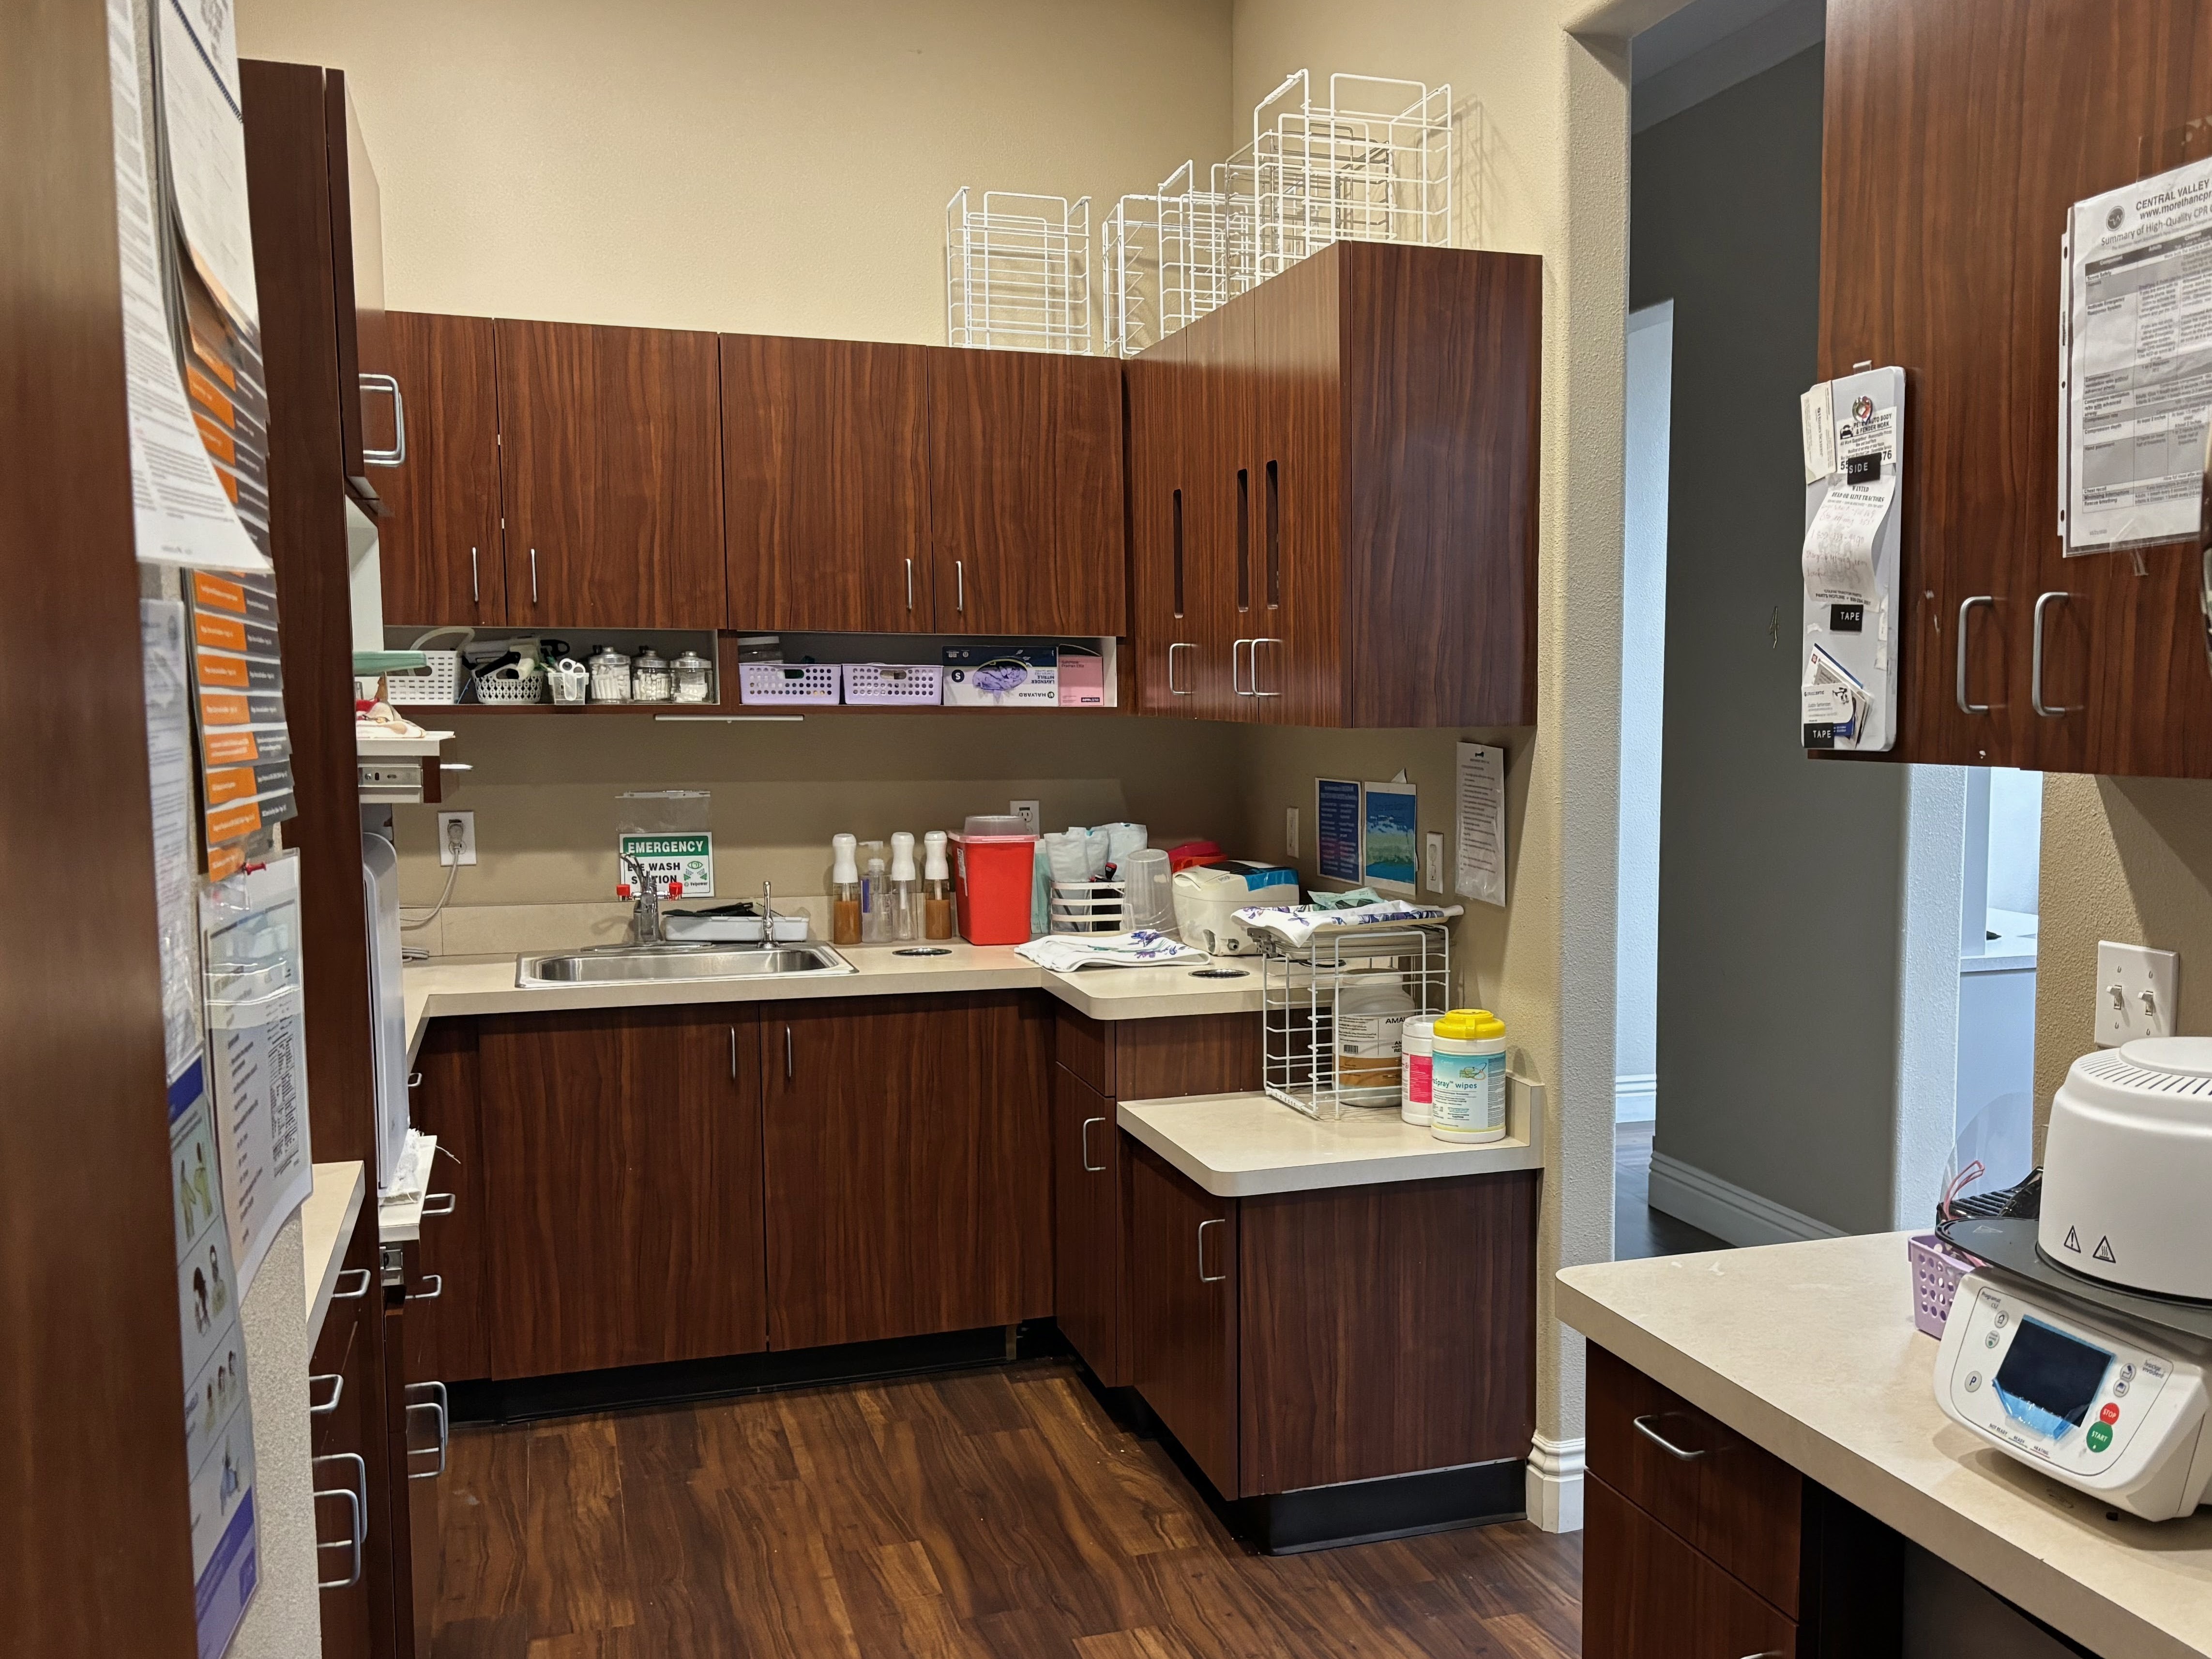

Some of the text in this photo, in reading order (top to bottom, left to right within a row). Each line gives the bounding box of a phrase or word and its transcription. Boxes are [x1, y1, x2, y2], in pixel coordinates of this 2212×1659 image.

[2136, 179, 2210, 211] CENTRAL VALLEY
[2101, 230, 2135, 246] Summary
[2136, 224, 2144, 236] of
[2146, 212, 2192, 232] High-Quality
[2194, 205, 2208, 218] CPR
[1880, 413, 1892, 422] BODY
[1860, 424, 1876, 433] FENDER
[1877, 421, 1890, 430] WORK
[1849, 462, 1868, 473] SIDE
[1840, 612, 1860, 621] TAPE
[955, 672, 962, 681] S
[1813, 730, 1831, 738] TAPE
[628, 841, 703, 853] EMERGENCY
[649, 862, 681, 871] WASH
[1970, 1376, 1977, 1386] P
[2103, 1408, 2117, 1418] STOP
[1997, 1426, 2008, 1435] READY
[2014, 1435, 2025, 1444] READY
[2091, 1431, 2108, 1442] START
[2034, 1446, 2050, 1456] HEATING
